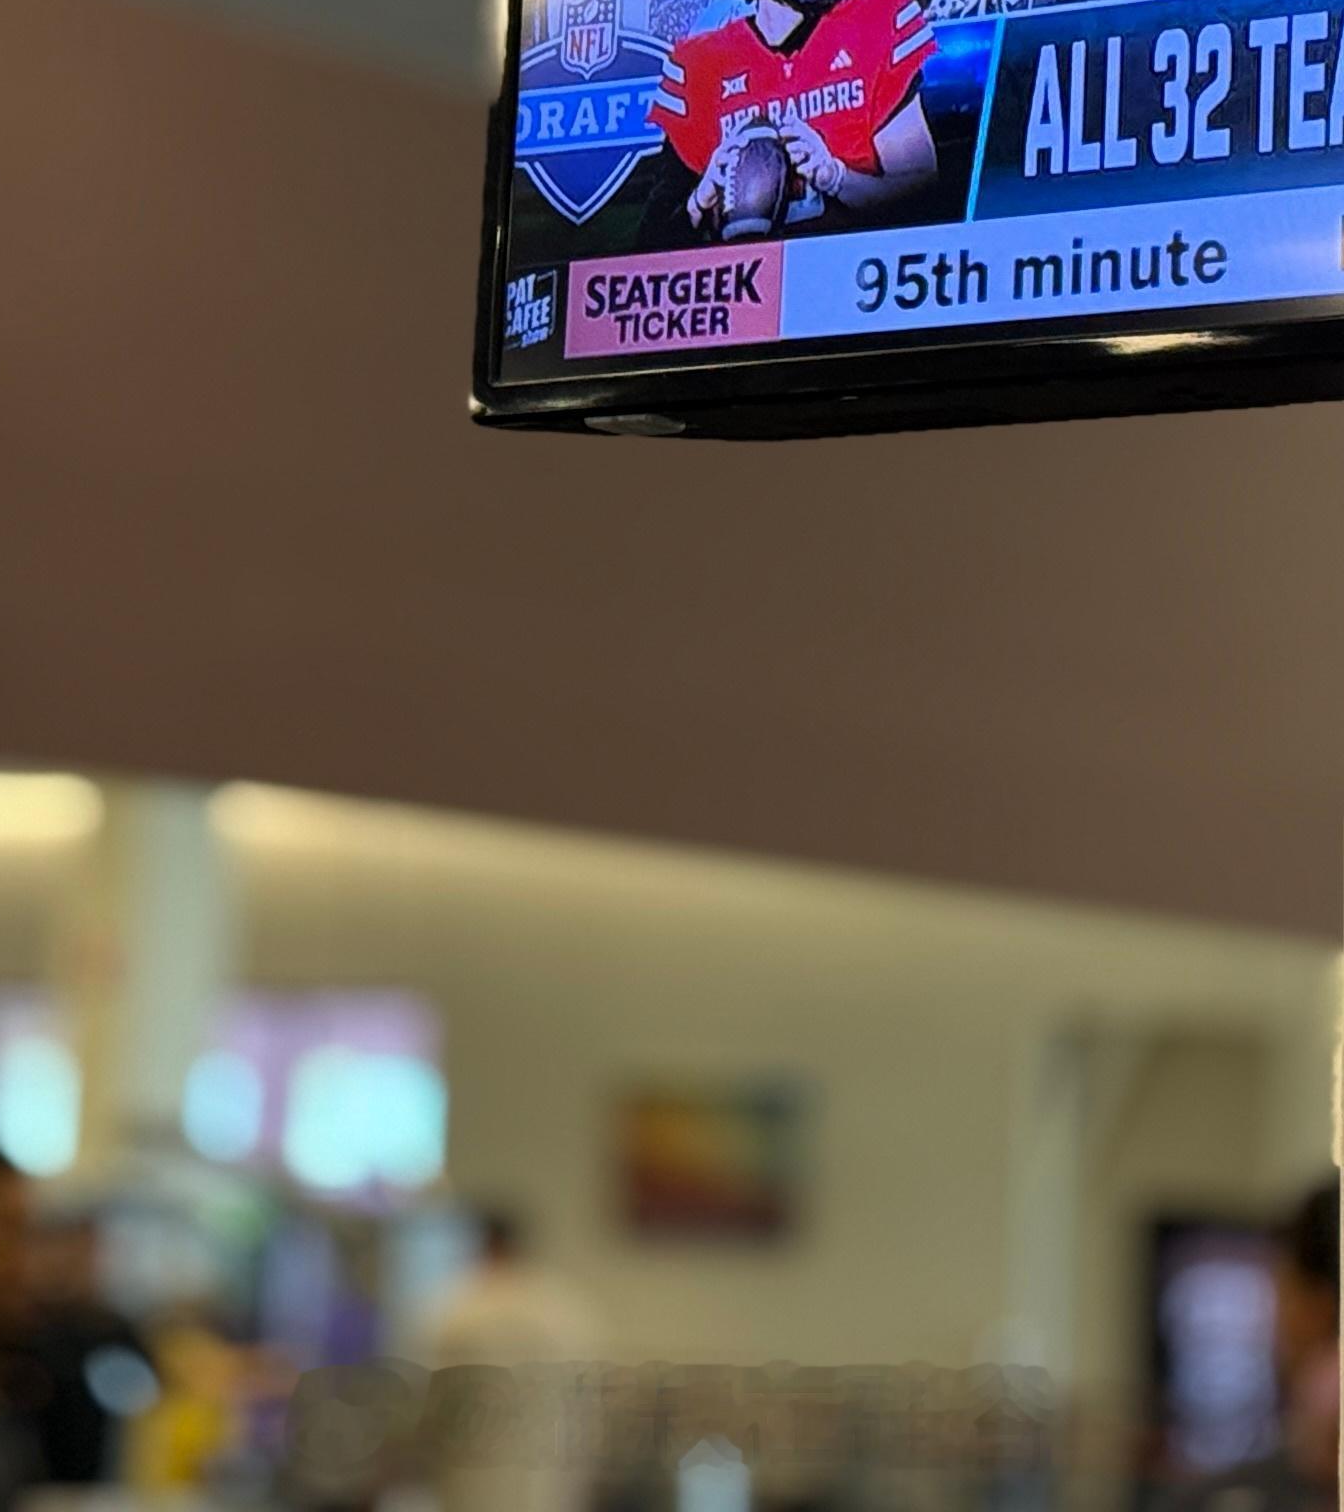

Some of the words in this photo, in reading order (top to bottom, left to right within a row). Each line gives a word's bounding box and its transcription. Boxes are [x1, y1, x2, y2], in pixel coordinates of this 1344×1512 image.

[569, 26, 610, 65] NFL
[767, 78, 865, 126] RAIDERS
[1024, 37, 1137, 177] ALL
[1151, 23, 1232, 164] 32
[584, 258, 763, 319] SEATGEEK
[856, 249, 988, 313] 95th
[1012, 230, 1227, 300] minute
[613, 305, 730, 344] TICKER
